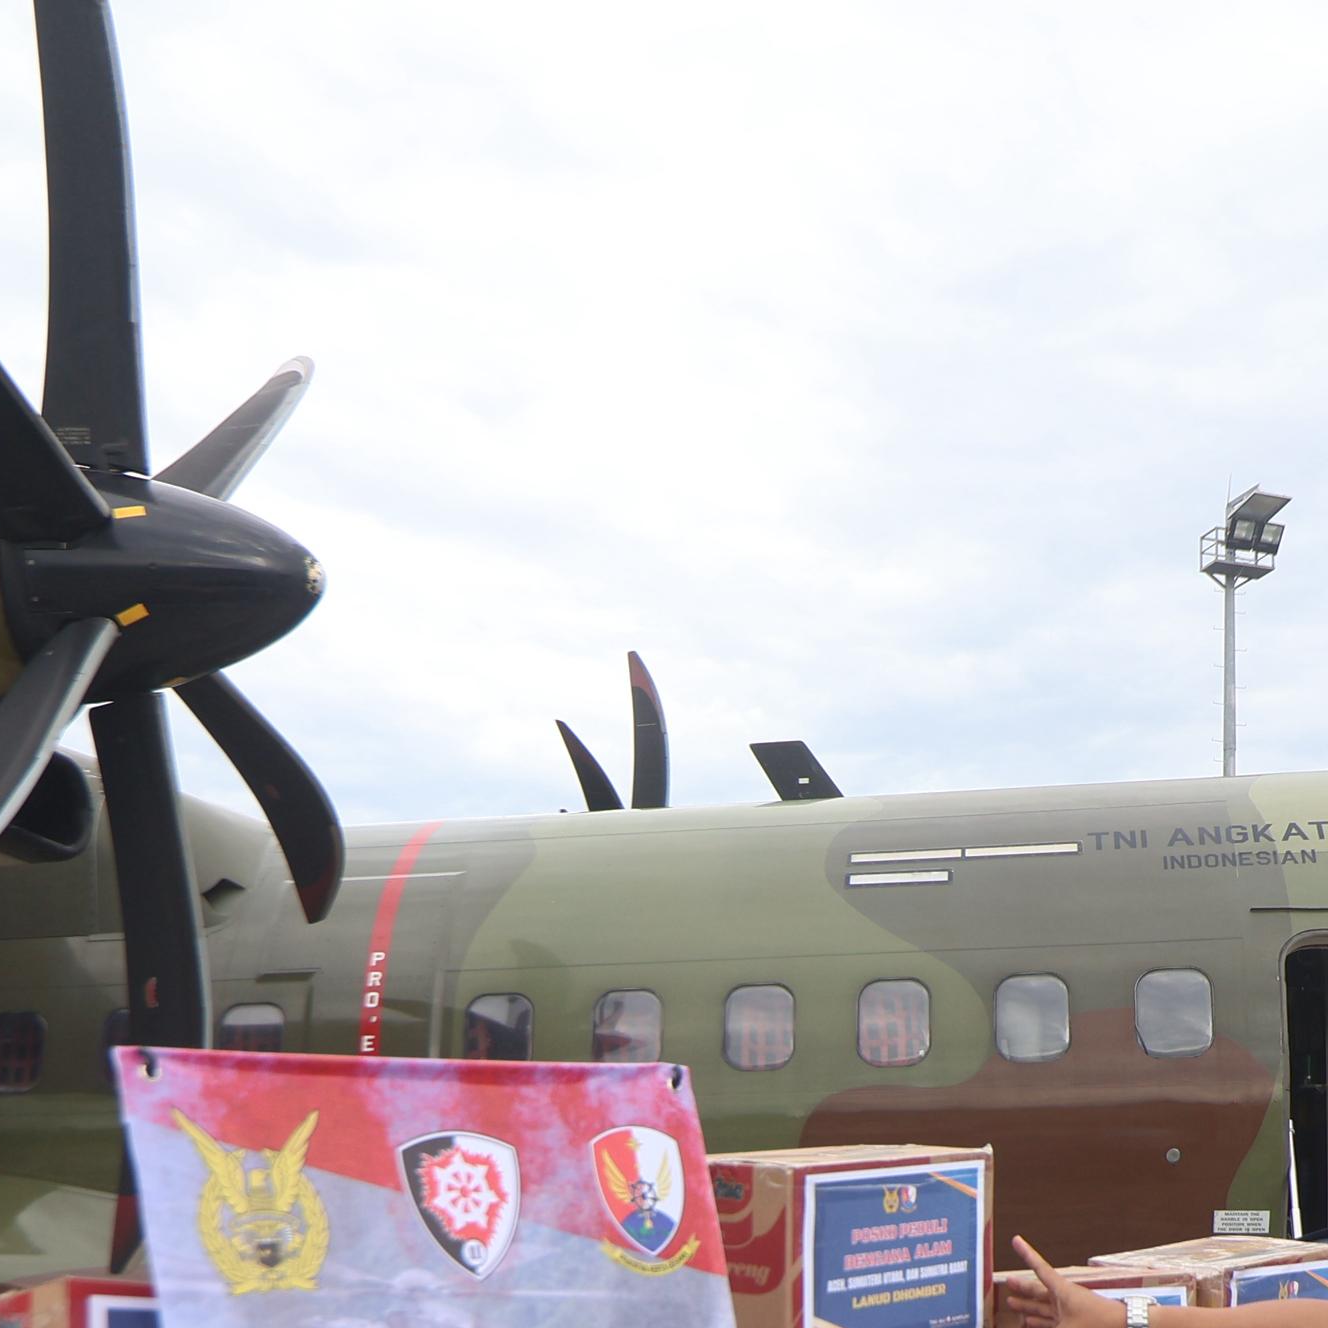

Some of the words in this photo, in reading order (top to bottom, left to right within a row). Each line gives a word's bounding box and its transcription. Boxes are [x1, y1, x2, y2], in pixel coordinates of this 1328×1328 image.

[1087, 829, 1149, 852] TNI
[1162, 848, 1318, 871] INDONESIAN
[851, 1223, 897, 1245] POSKO
[898, 1217, 947, 1238] PEDULI
[843, 1246, 911, 1270] BENCANA
[913, 1239, 952, 1259] ALAM
[852, 1291, 890, 1308] LANUD
[892, 1282, 945, 1302] DHOMBER
